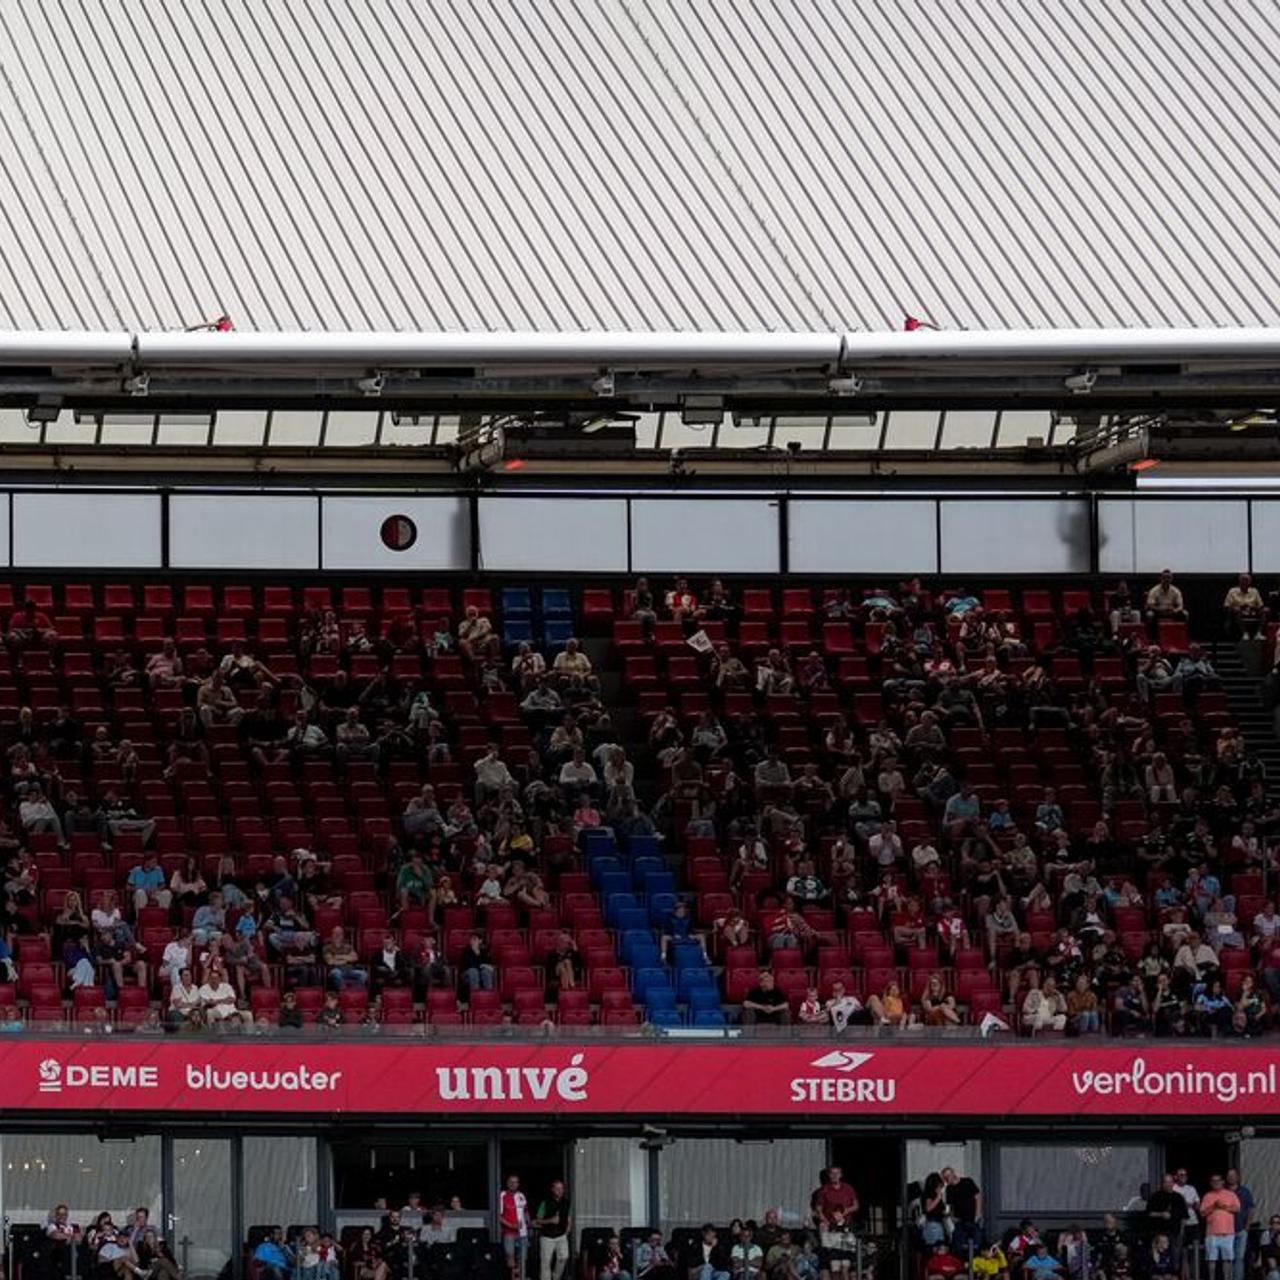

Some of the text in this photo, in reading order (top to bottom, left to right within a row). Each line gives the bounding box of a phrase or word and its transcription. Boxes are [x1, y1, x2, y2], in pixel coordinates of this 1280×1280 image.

[66, 1065, 159, 1088] DEME
[186, 1063, 342, 1090] bluewater
[435, 1053, 588, 1101] univé
[790, 1078, 896, 1102] STEBRU
[1072, 1057, 1277, 1103] verloning.nl
